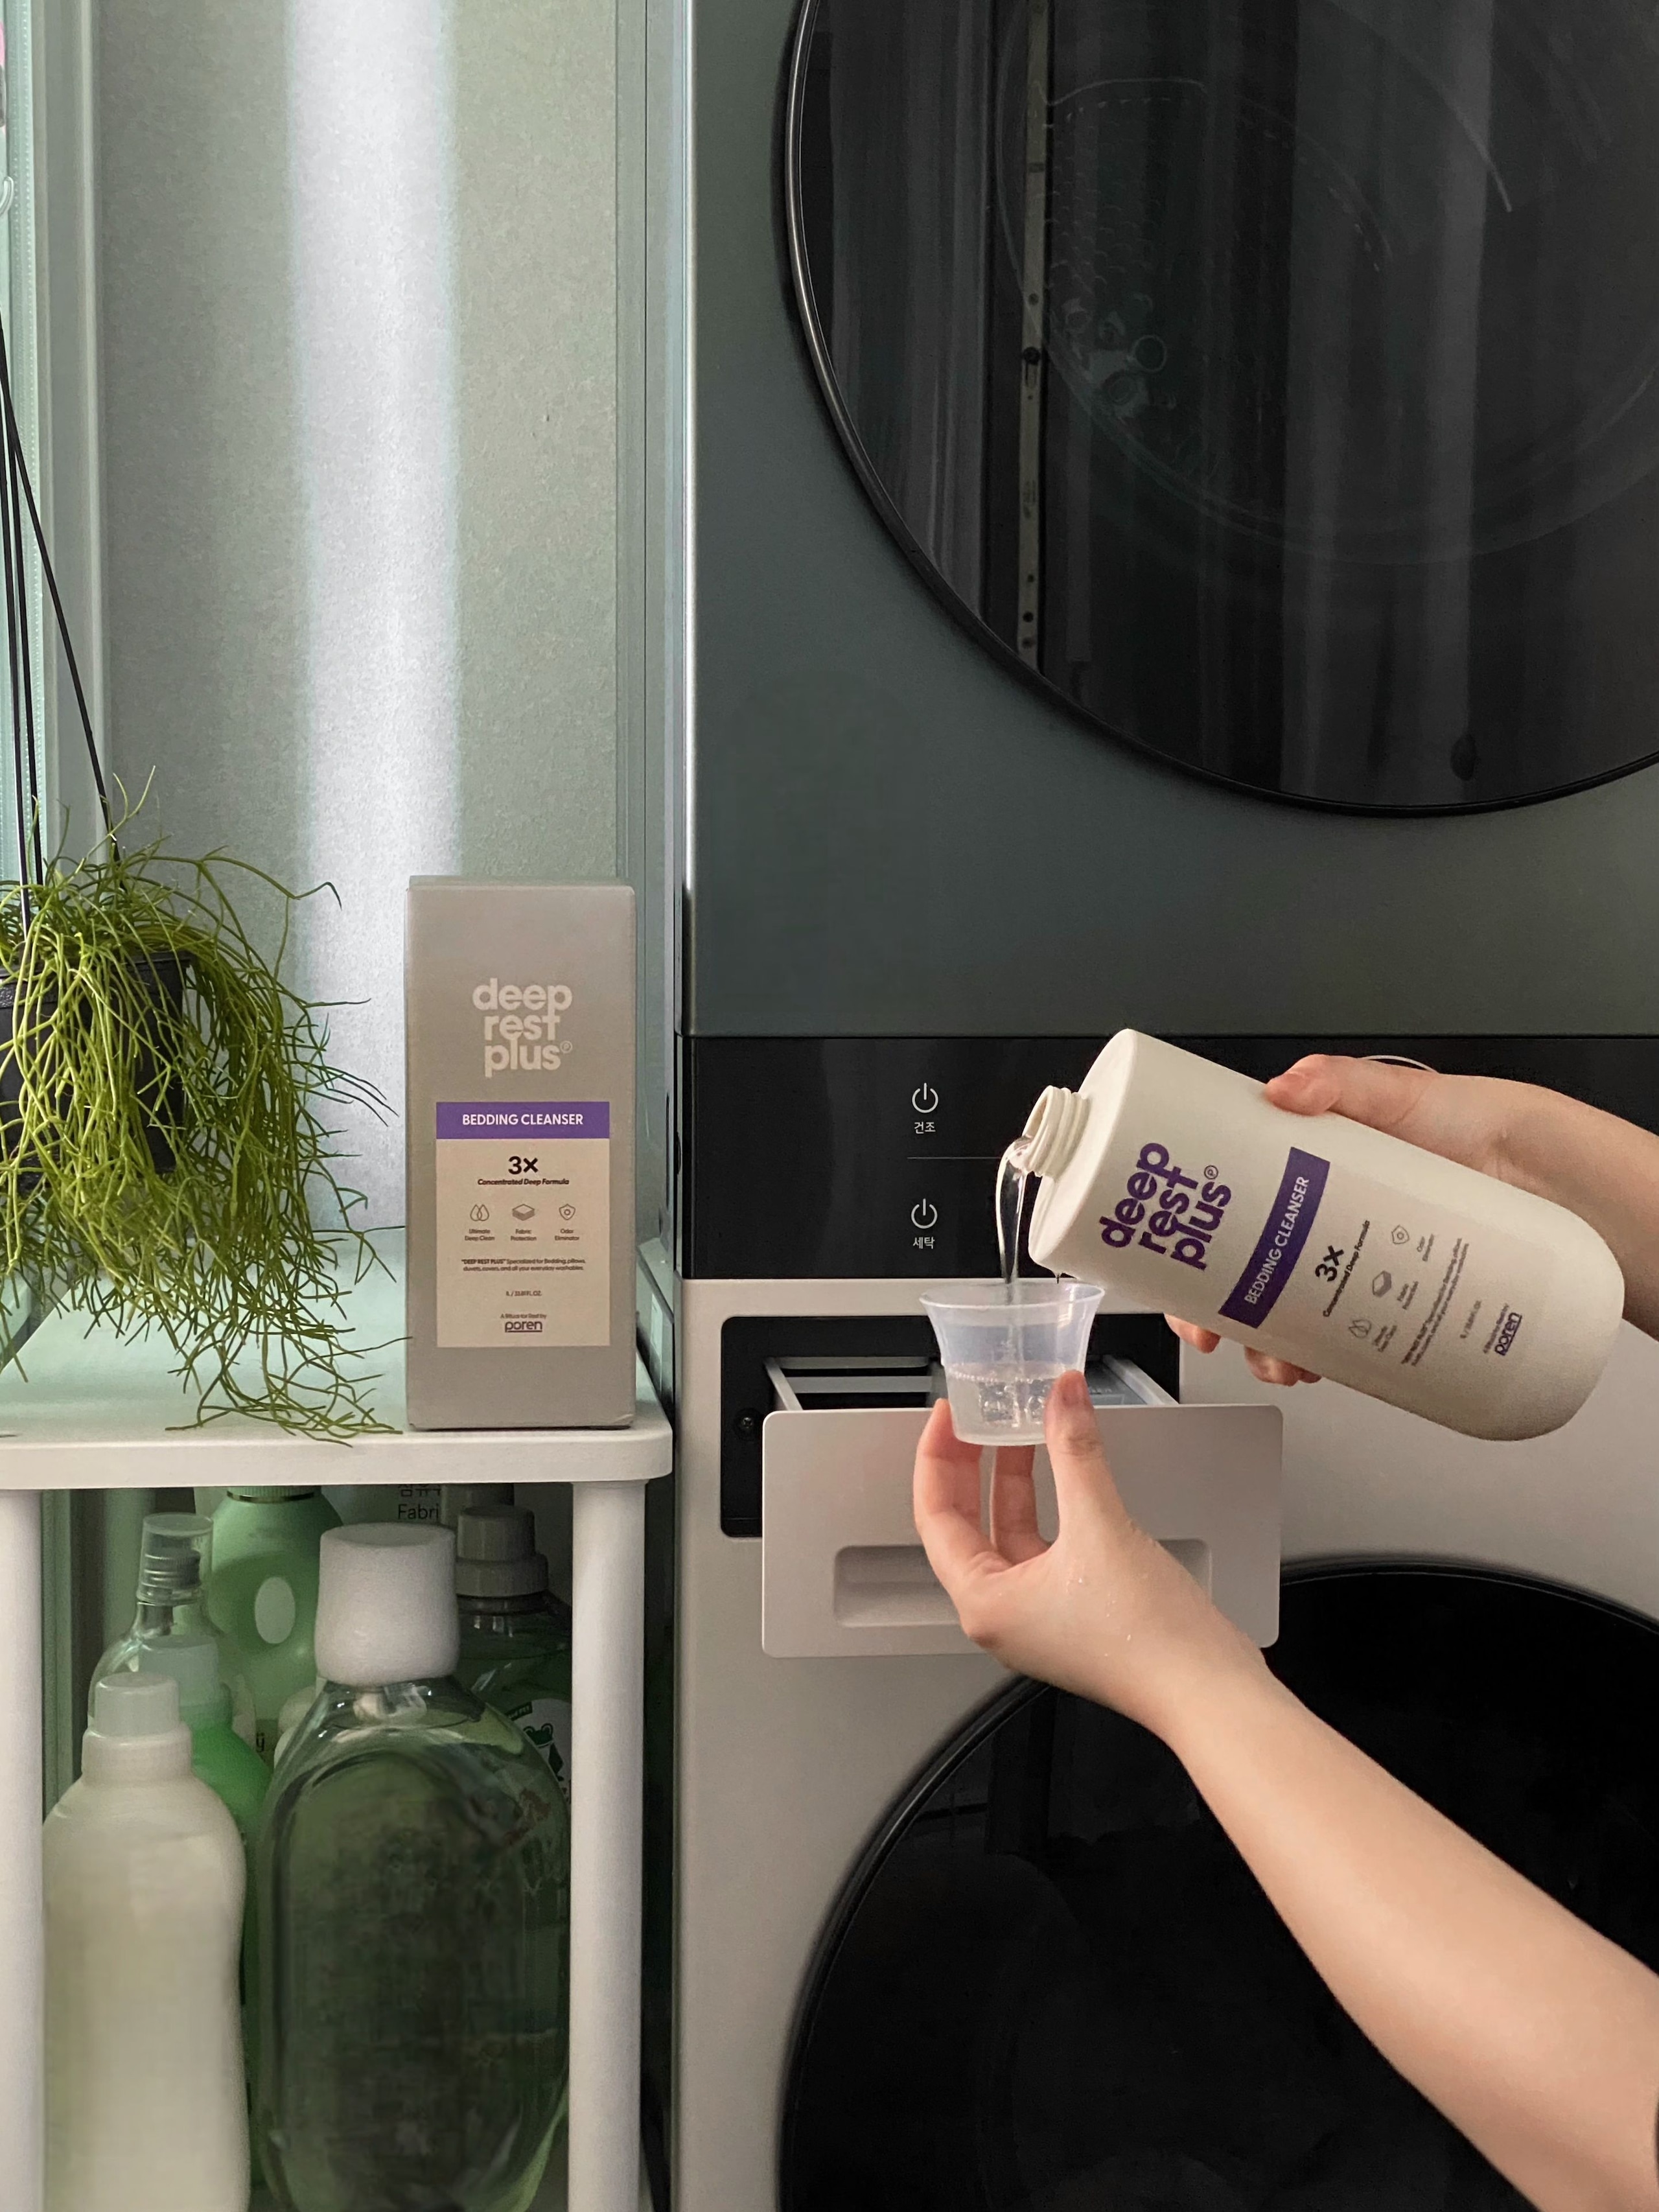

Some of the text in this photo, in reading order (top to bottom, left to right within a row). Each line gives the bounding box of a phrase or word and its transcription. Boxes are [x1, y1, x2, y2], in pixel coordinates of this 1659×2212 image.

[472, 977, 573, 1014] deep
[484, 1014, 561, 1040] rest
[462, 1113, 583, 1125] BEDDING CLEANSER
[914, 1121, 936, 1134] 건조
[1099, 1143, 1170, 1248] deep
[1138, 1166, 1199, 1255] rest
[912, 1237, 935, 1250] 세탁
[1244, 1176, 1310, 1305] BEDDING CLEANSER
[505, 1321, 542, 1333] poren
[1494, 1312, 1522, 1356] poren
